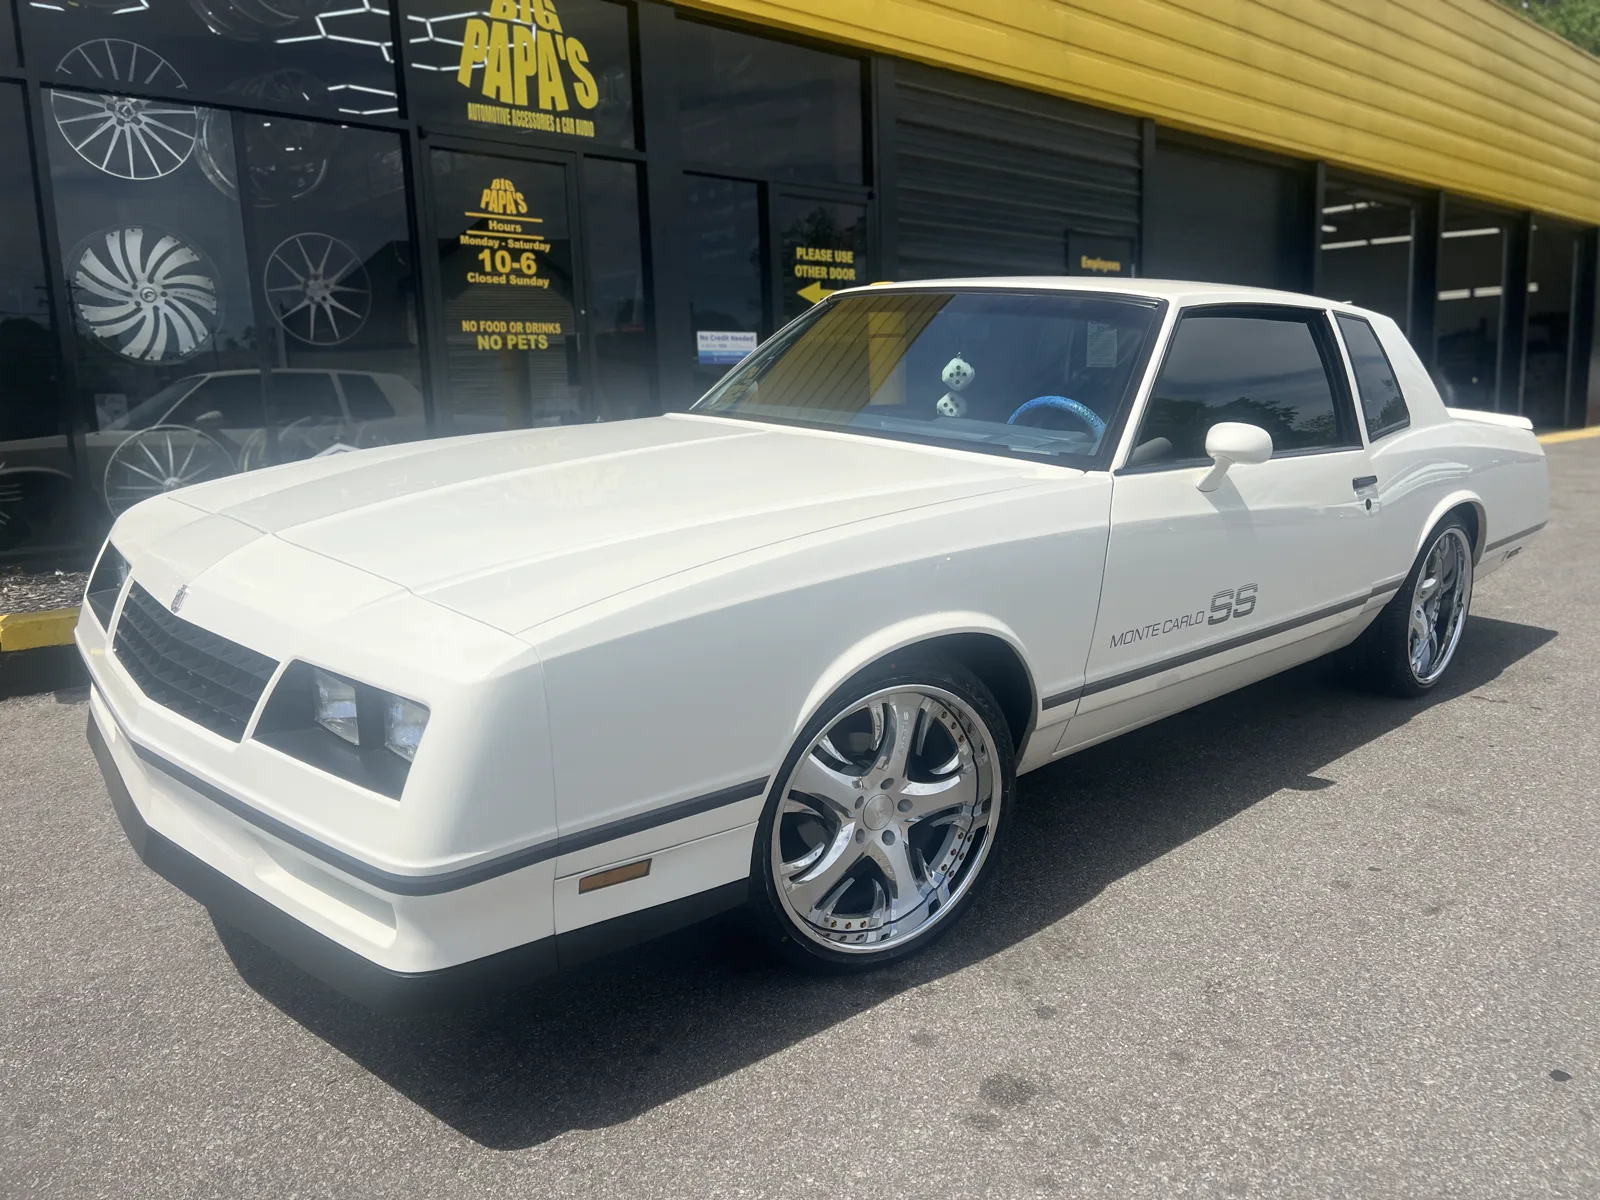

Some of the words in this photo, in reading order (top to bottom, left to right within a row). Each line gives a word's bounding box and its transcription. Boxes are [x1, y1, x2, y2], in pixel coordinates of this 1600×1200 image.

[489, 0, 563, 33] BIG
[457, 18, 599, 112] PAPA'S
[467, 102, 511, 126] AUTOMOTIVE
[511, 109, 555, 132] ACCESSORIES
[561, 116, 575, 135] CAR
[575, 119, 595, 138] AUDIO
[491, 178, 515, 192] BIG
[480, 188, 528, 214] PAPA'S
[488, 220, 522, 233] Hours
[460, 235, 499, 249] Monday
[507, 239, 551, 253] Saturday
[478, 248, 537, 275] 10-6
[796, 246, 833, 262] PLEASE
[834, 250, 854, 264] USE
[467, 272, 507, 285] Closed
[509, 275, 550, 289] Sunday
[795, 264, 828, 279] OTHER
[829, 267, 856, 281] DOOR
[462, 320, 477, 332] NO
[480, 321, 507, 333] FOOD
[509, 322, 523, 333] OR
[525, 322, 561, 334] DRINKS
[477, 335, 502, 350] NO
[507, 334, 548, 350] PETS
[1109, 623, 1161, 649] MONTE
[1162, 611, 1205, 634] CARLO
[1208, 582, 1259, 626] SS
